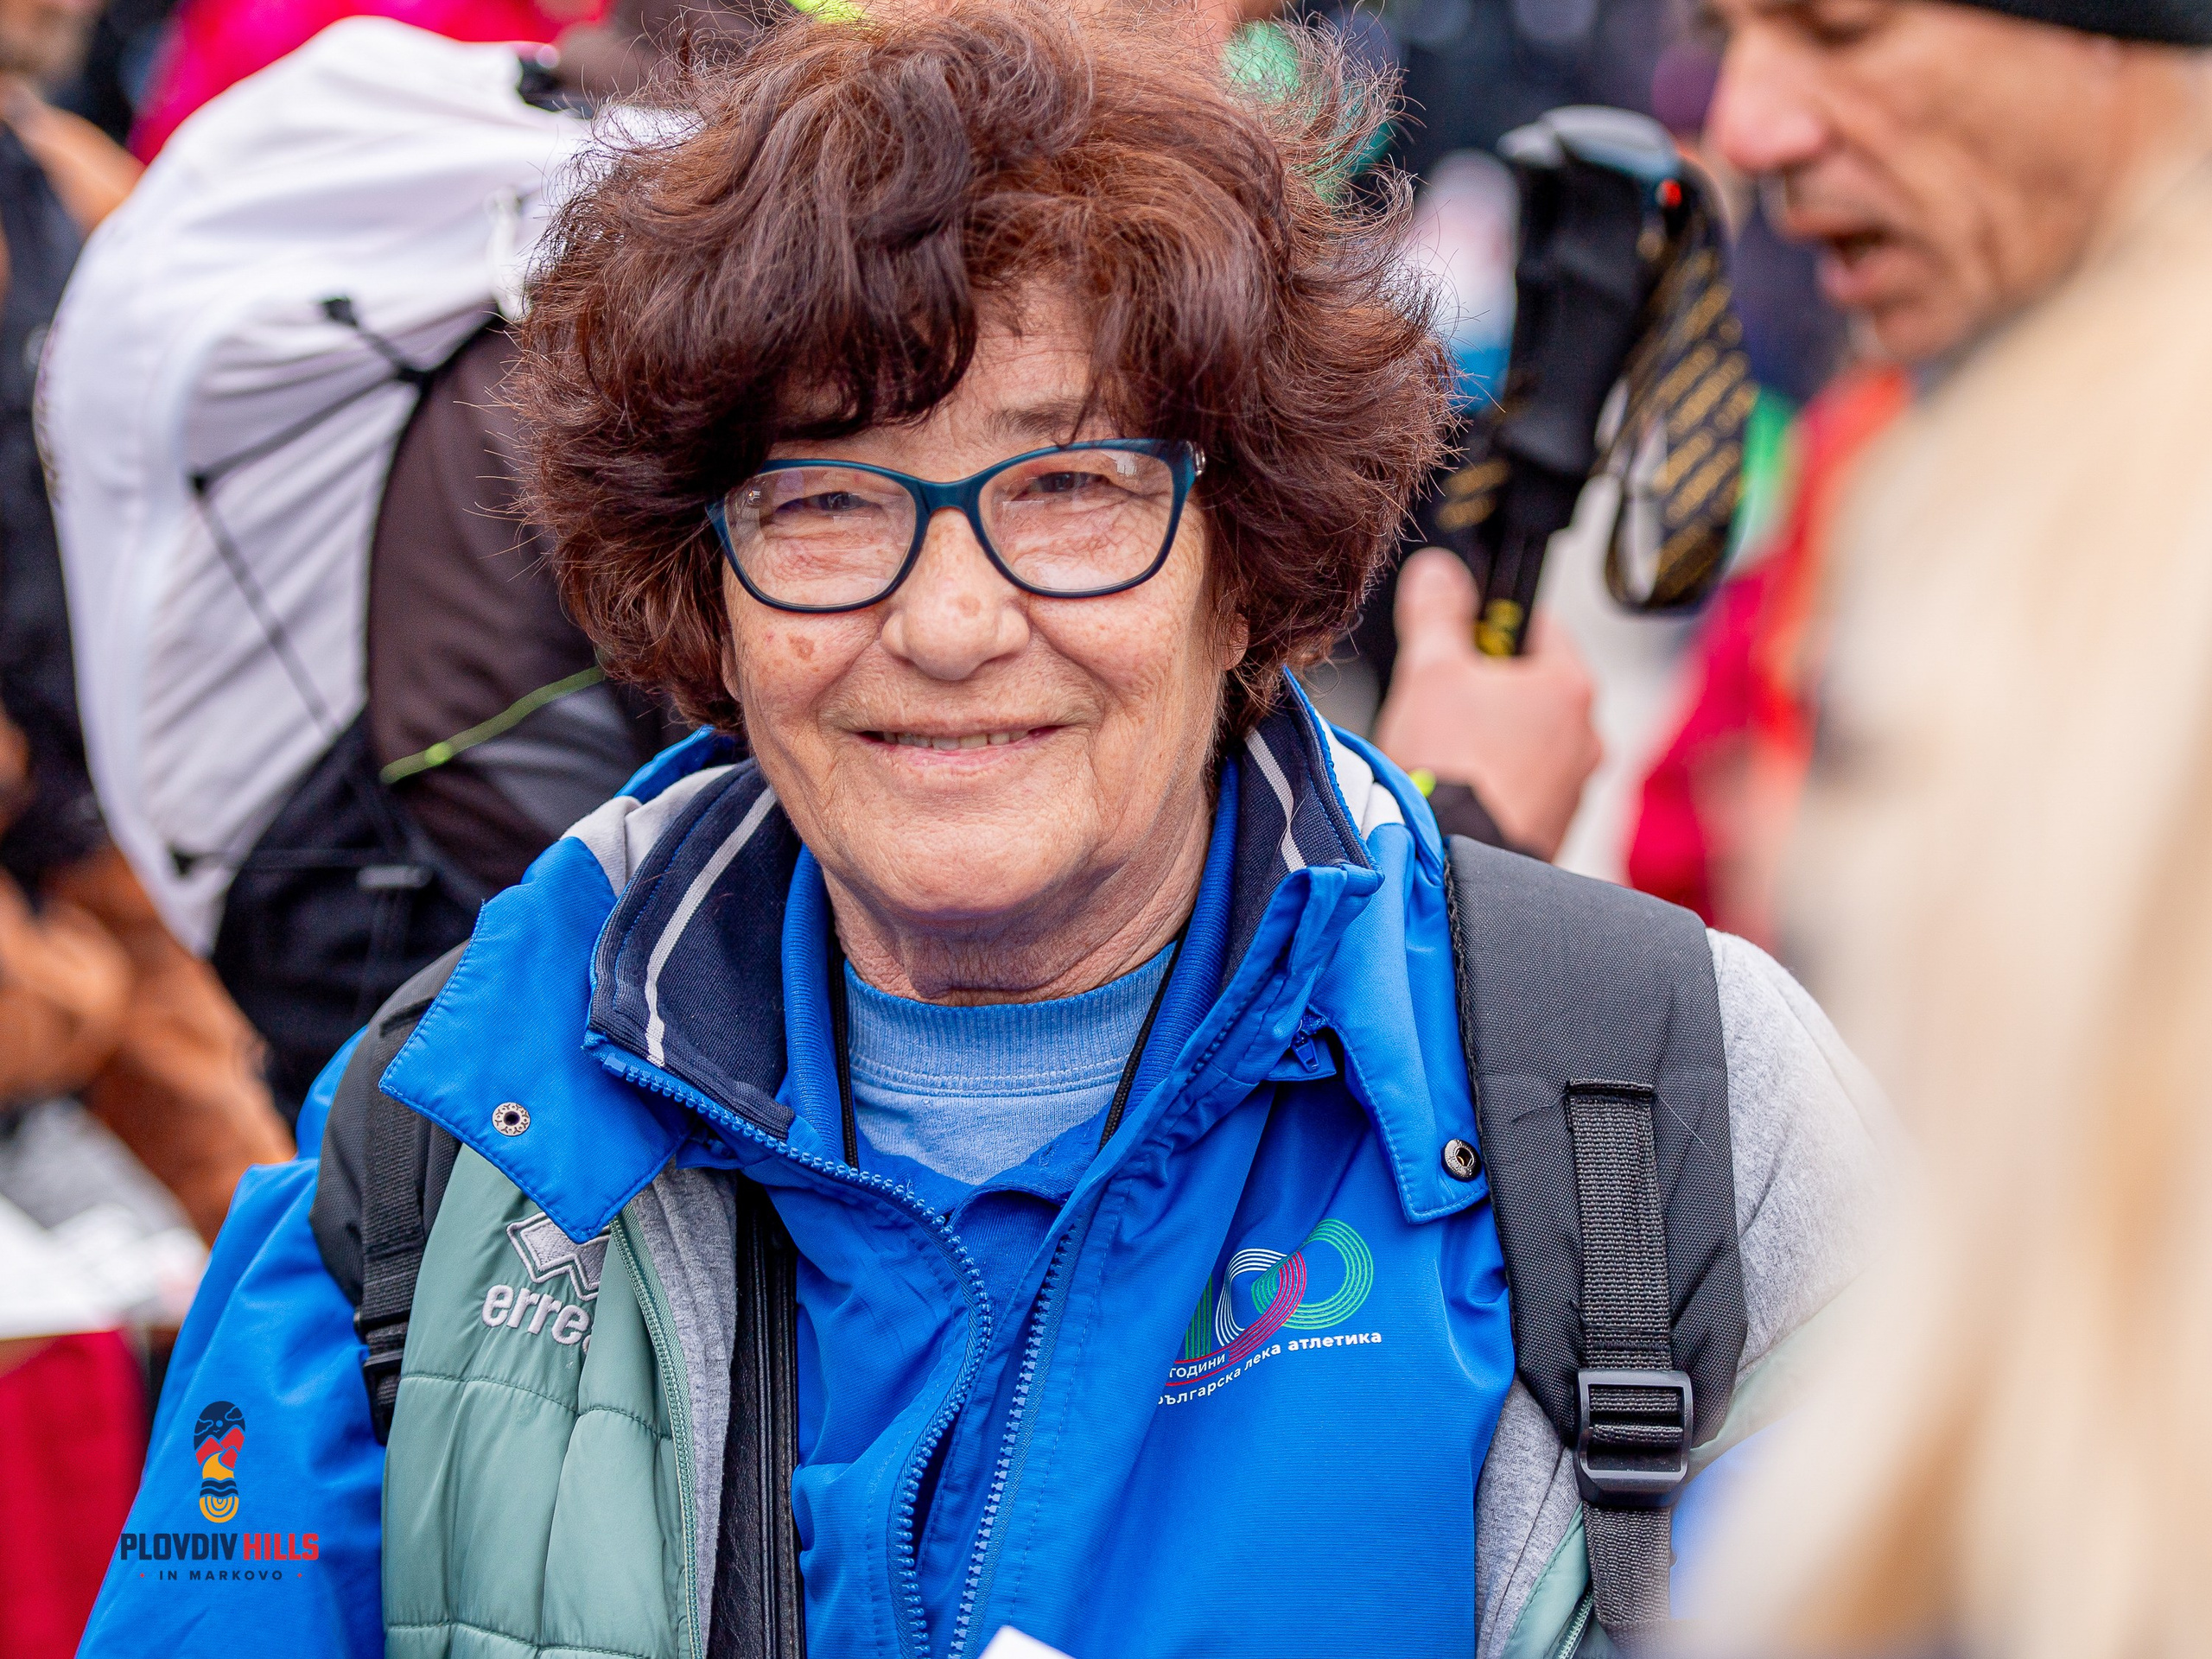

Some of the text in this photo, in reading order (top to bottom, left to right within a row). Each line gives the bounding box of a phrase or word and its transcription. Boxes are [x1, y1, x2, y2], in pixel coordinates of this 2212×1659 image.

[481, 1284, 591, 1355] erre
[1169, 1353, 1225, 1379] години
[1244, 1344, 1281, 1371] лека
[1287, 1332, 1382, 1351] атлетика
